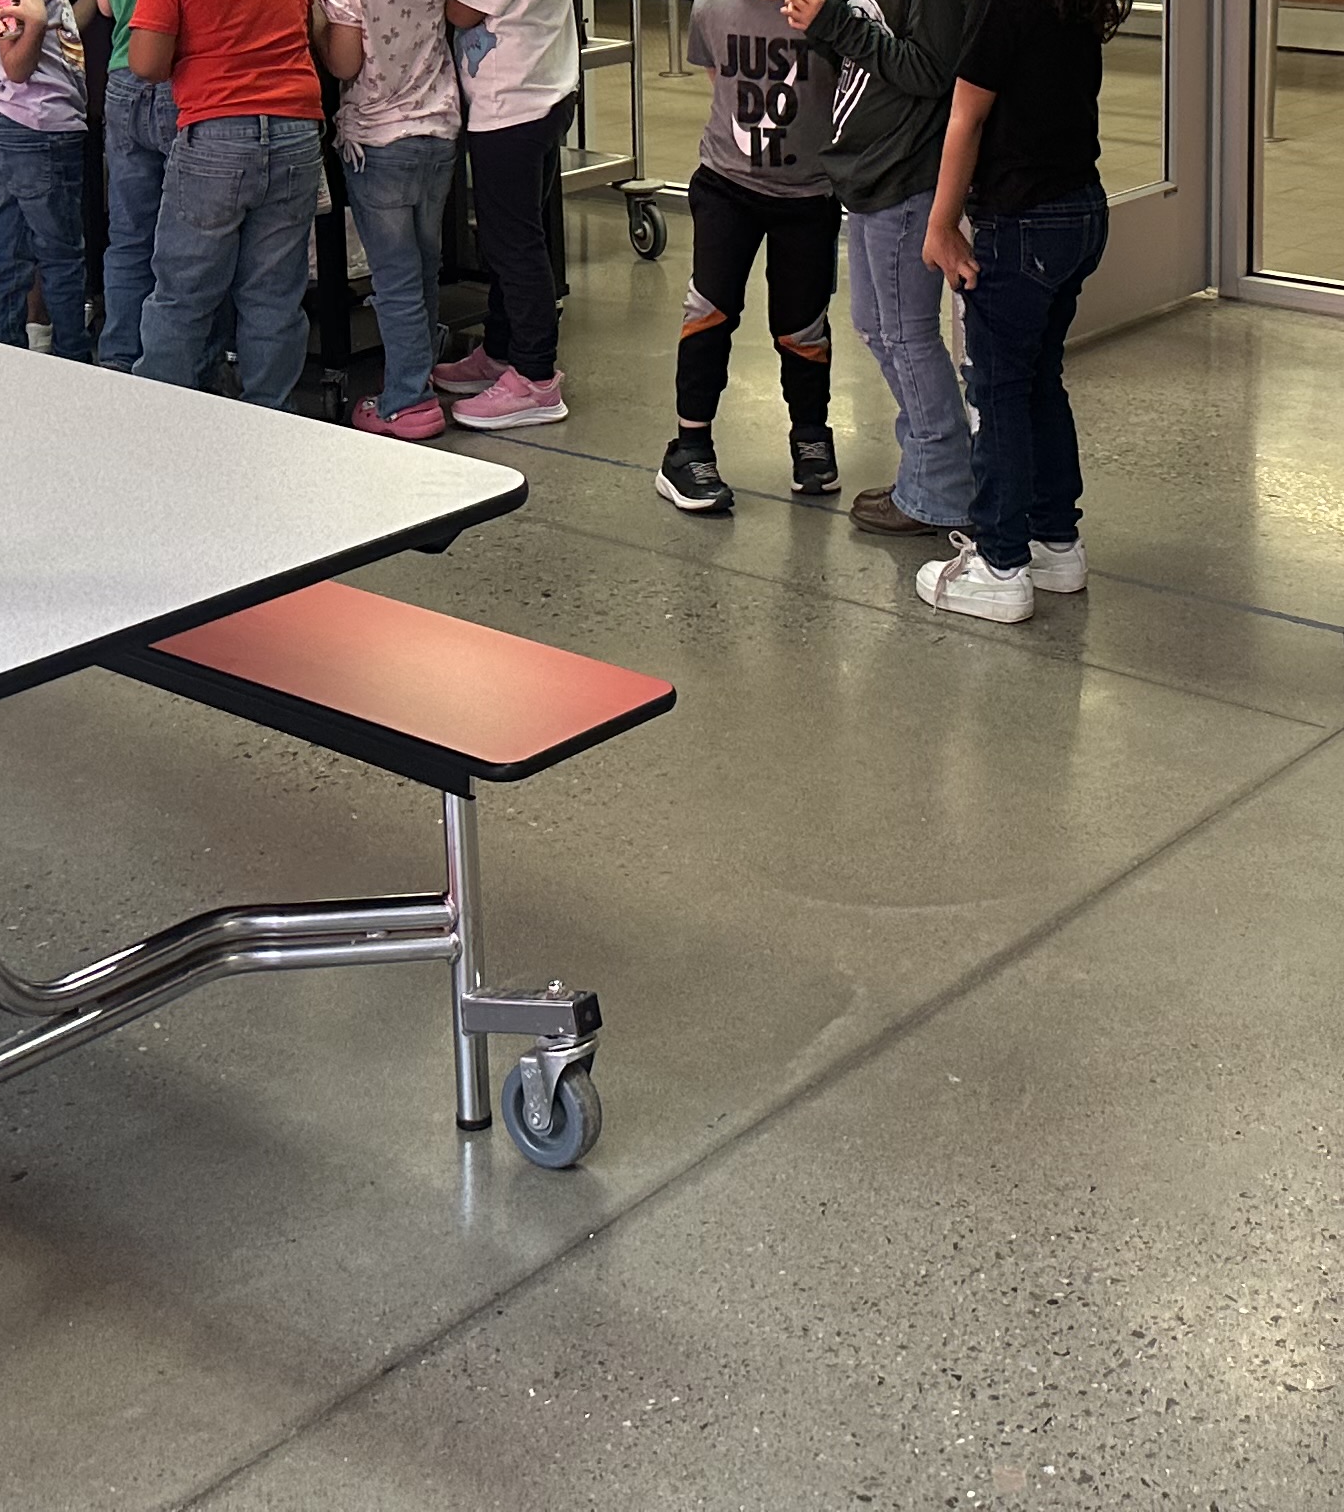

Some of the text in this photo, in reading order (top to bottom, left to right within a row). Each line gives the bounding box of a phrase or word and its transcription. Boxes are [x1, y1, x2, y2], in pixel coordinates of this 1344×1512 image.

[721, 34, 812, 81] JUST
[737, 81, 798, 126] DO
[750, 127, 797, 167] IT.
